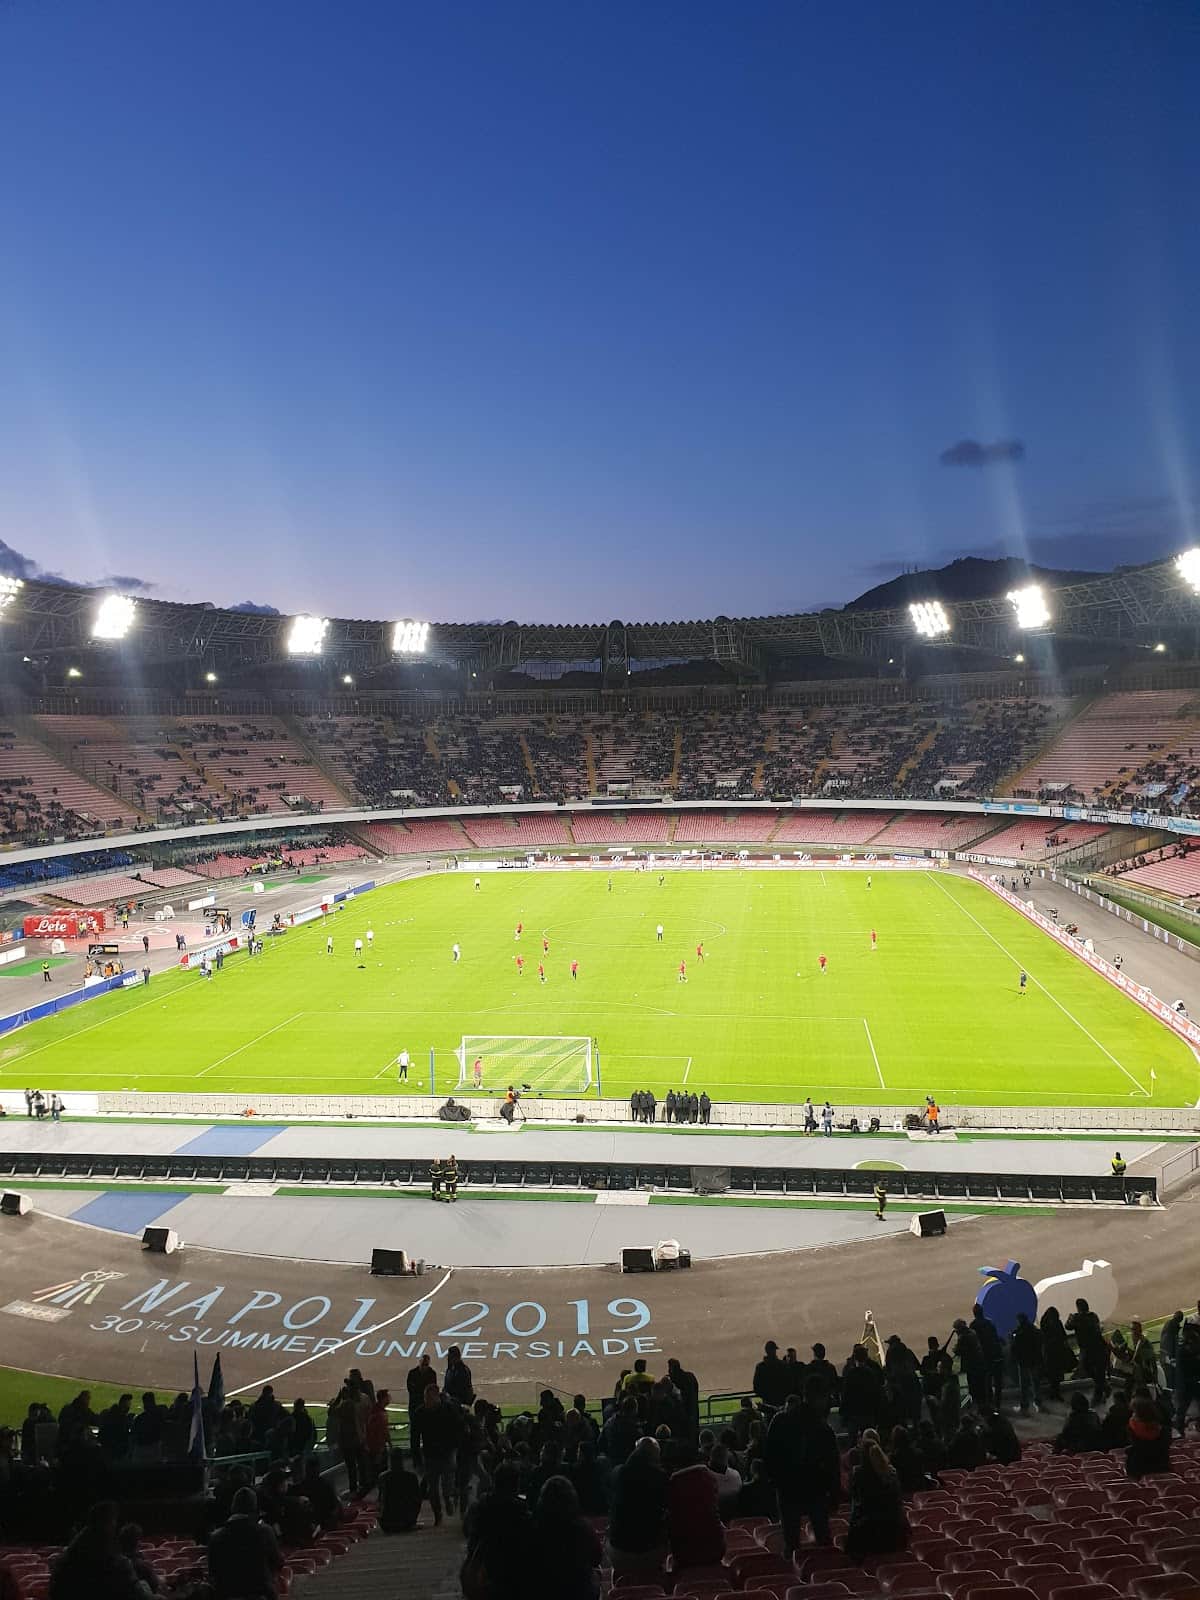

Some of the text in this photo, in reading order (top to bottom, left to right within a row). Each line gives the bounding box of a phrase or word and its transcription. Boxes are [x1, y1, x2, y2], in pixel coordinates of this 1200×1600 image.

[34, 919, 67, 932] Lete
[168, 1325, 345, 1355] SUMMER
[355, 1336, 663, 1359] UNIVERSIADE
